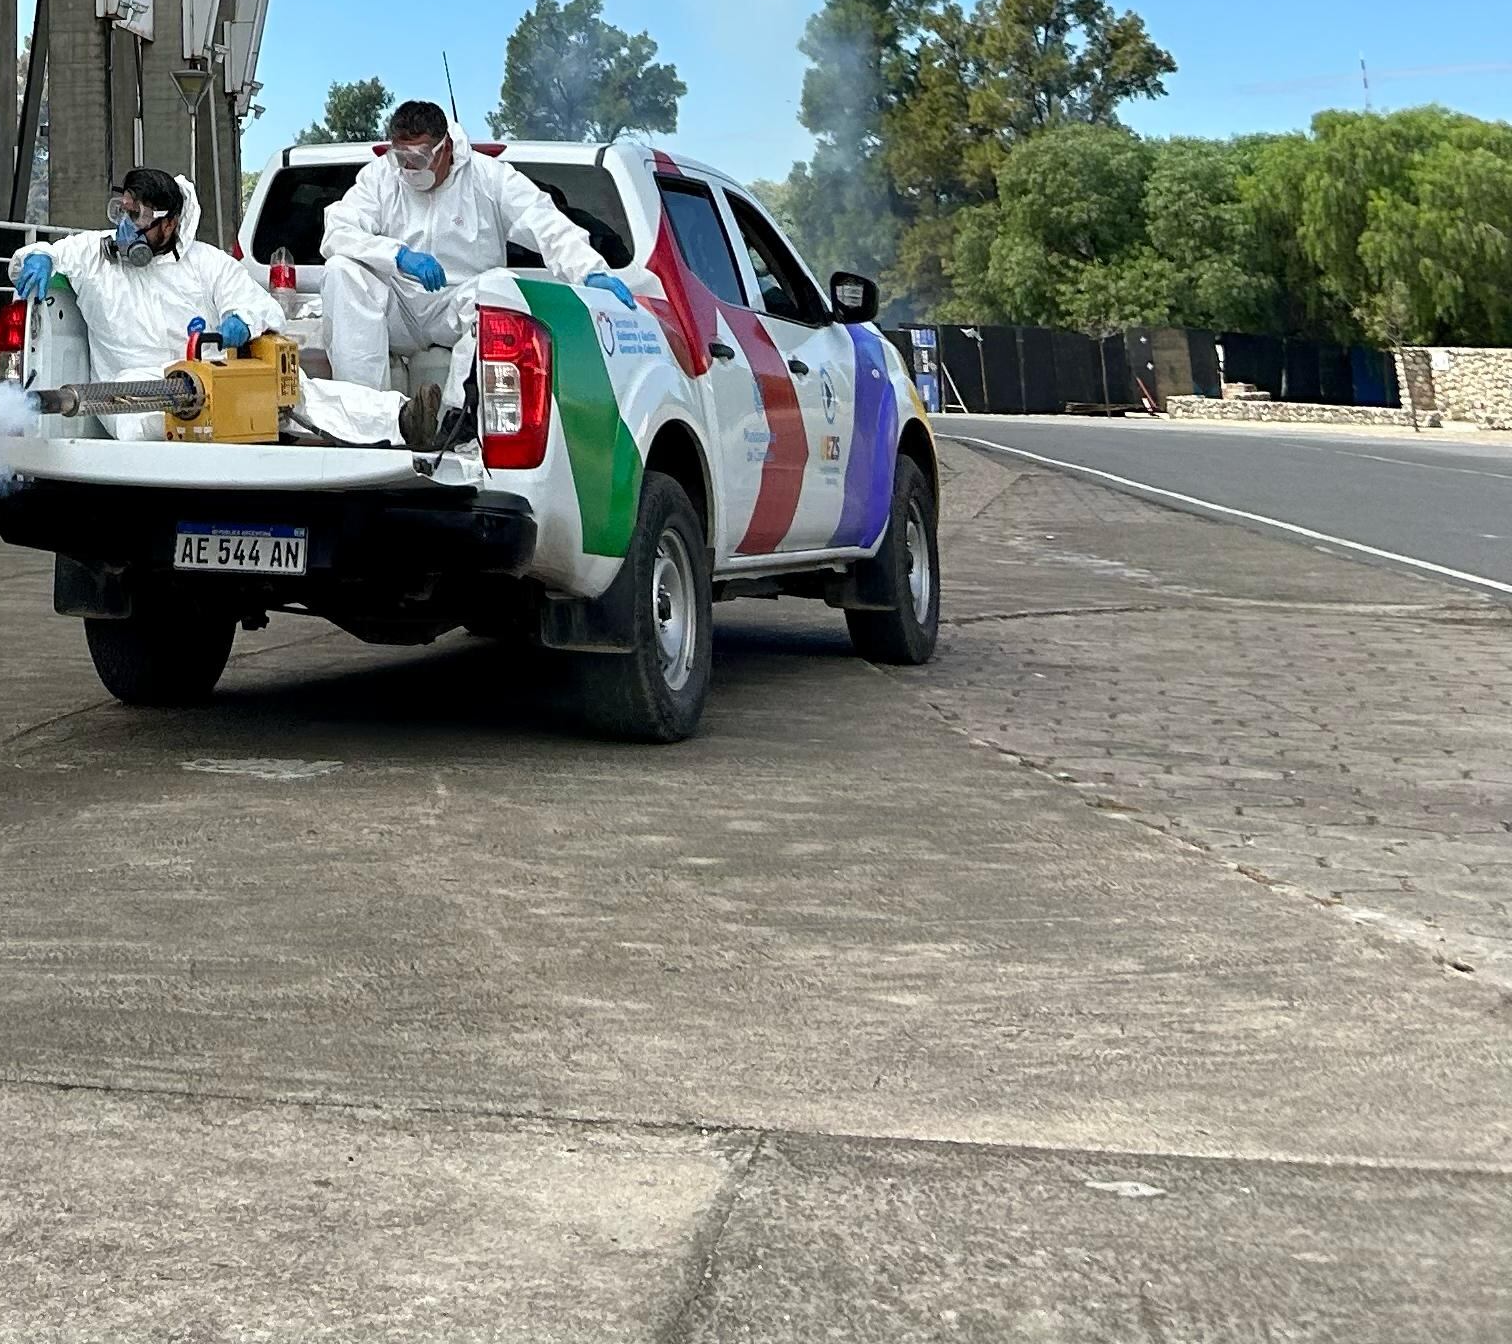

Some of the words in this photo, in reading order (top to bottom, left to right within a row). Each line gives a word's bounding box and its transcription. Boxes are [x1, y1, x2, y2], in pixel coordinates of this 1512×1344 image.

[181, 537, 210, 564] AE
[218, 538, 260, 567] 544
[270, 541, 300, 569] AN
